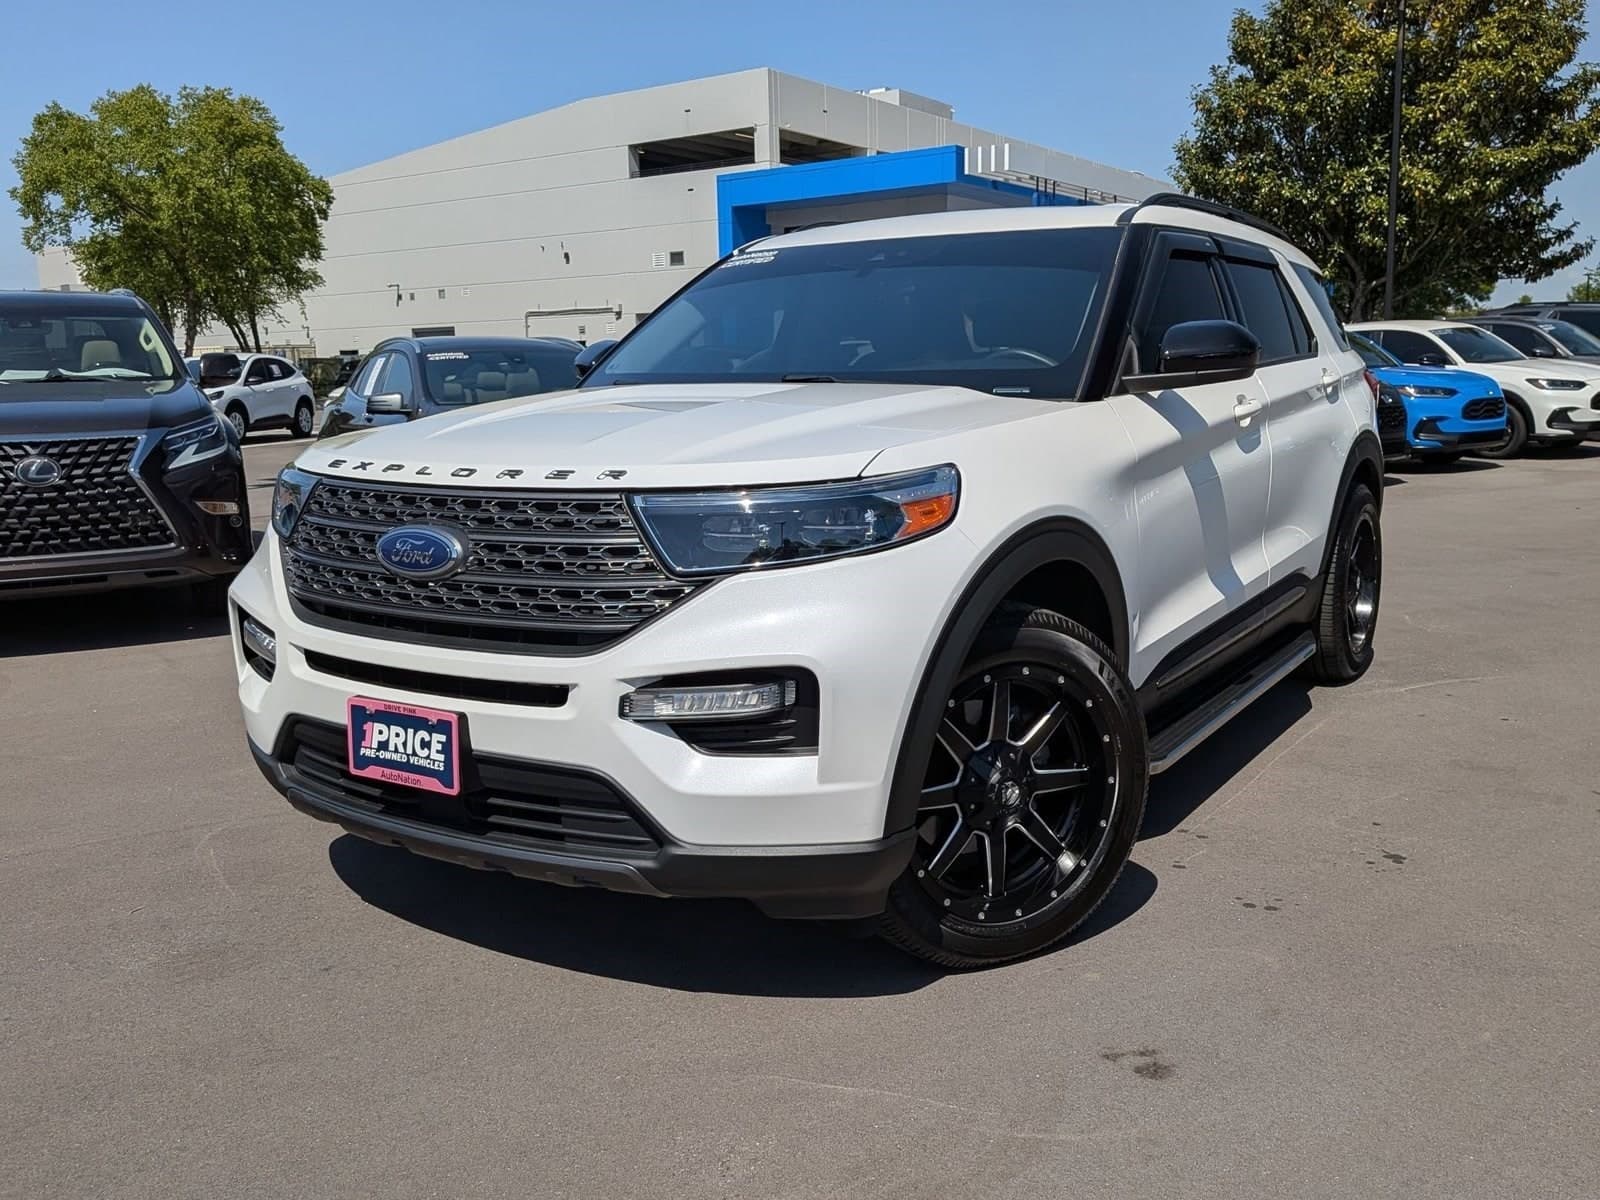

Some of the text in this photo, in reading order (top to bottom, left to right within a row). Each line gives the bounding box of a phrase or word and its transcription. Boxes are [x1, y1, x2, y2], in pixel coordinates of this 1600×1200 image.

[327, 459, 629, 481] EXPLORER
[391, 537, 434, 565] Ford
[383, 703, 417, 715] DRIVE PINK
[360, 747, 445, 771] PRE-OWNED VEHICLES
[381, 770, 422, 786] AutoNation
